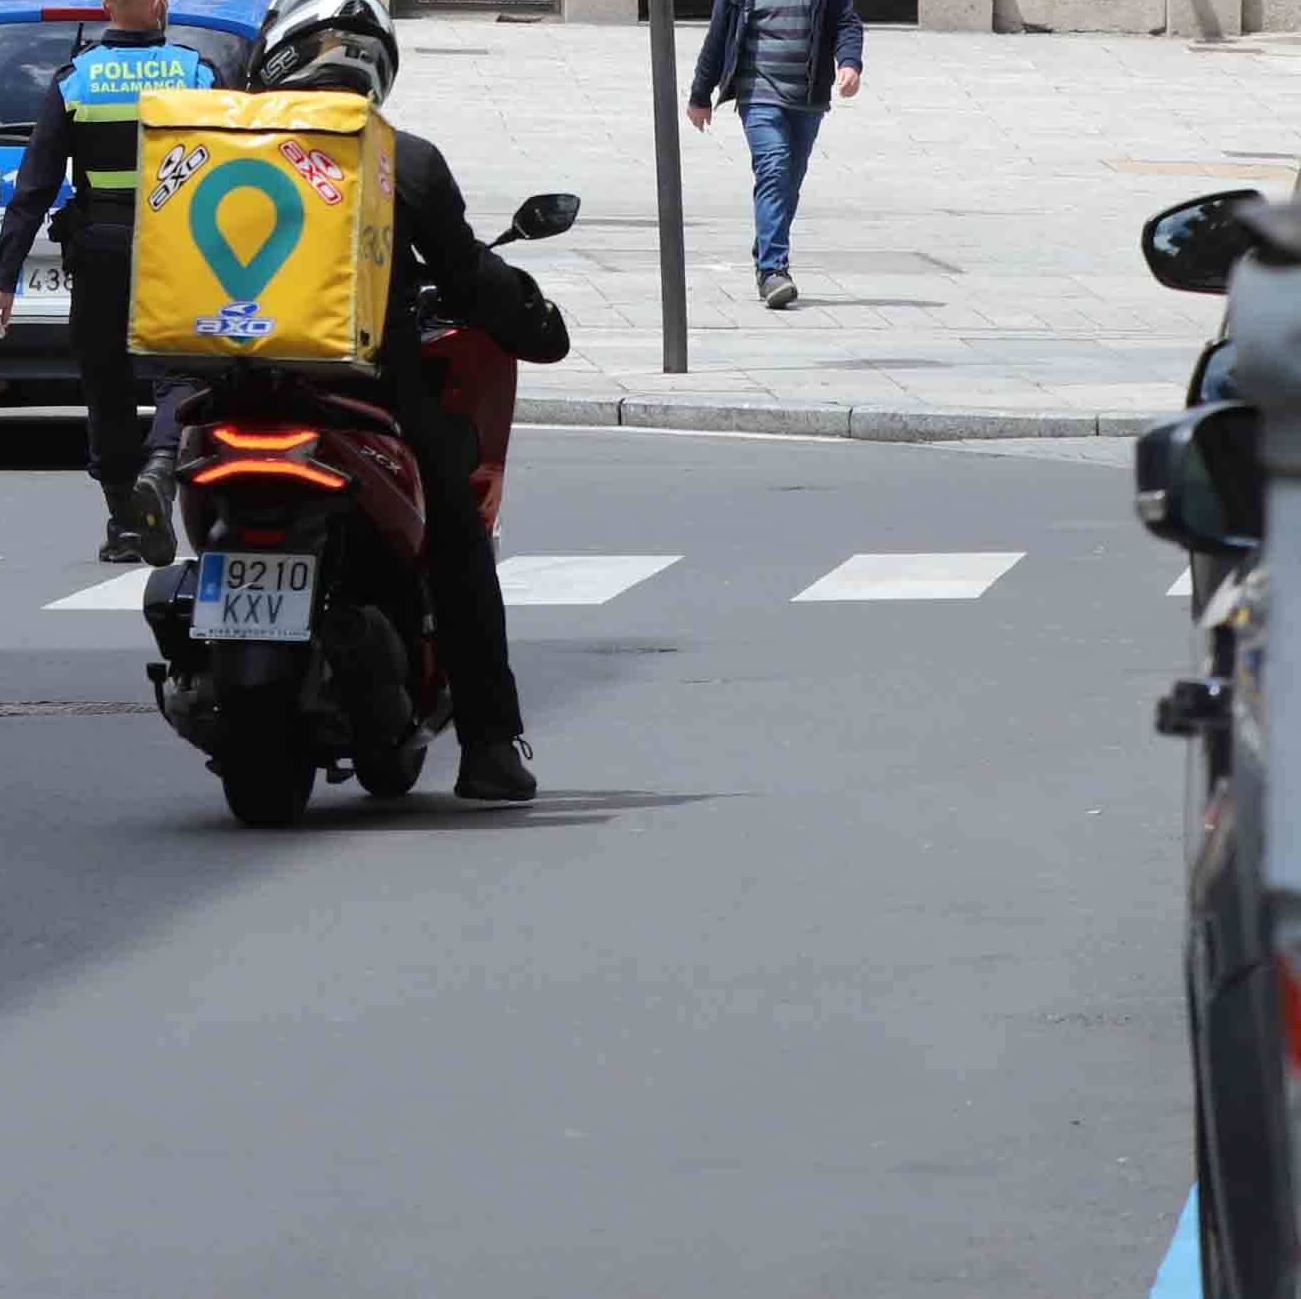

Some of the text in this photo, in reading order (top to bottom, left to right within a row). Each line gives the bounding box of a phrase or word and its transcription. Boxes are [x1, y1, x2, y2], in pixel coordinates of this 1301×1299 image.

[89, 60, 187, 80] POLICIA
[227, 559, 309, 591] 9210
[222, 594, 284, 624] KXV
